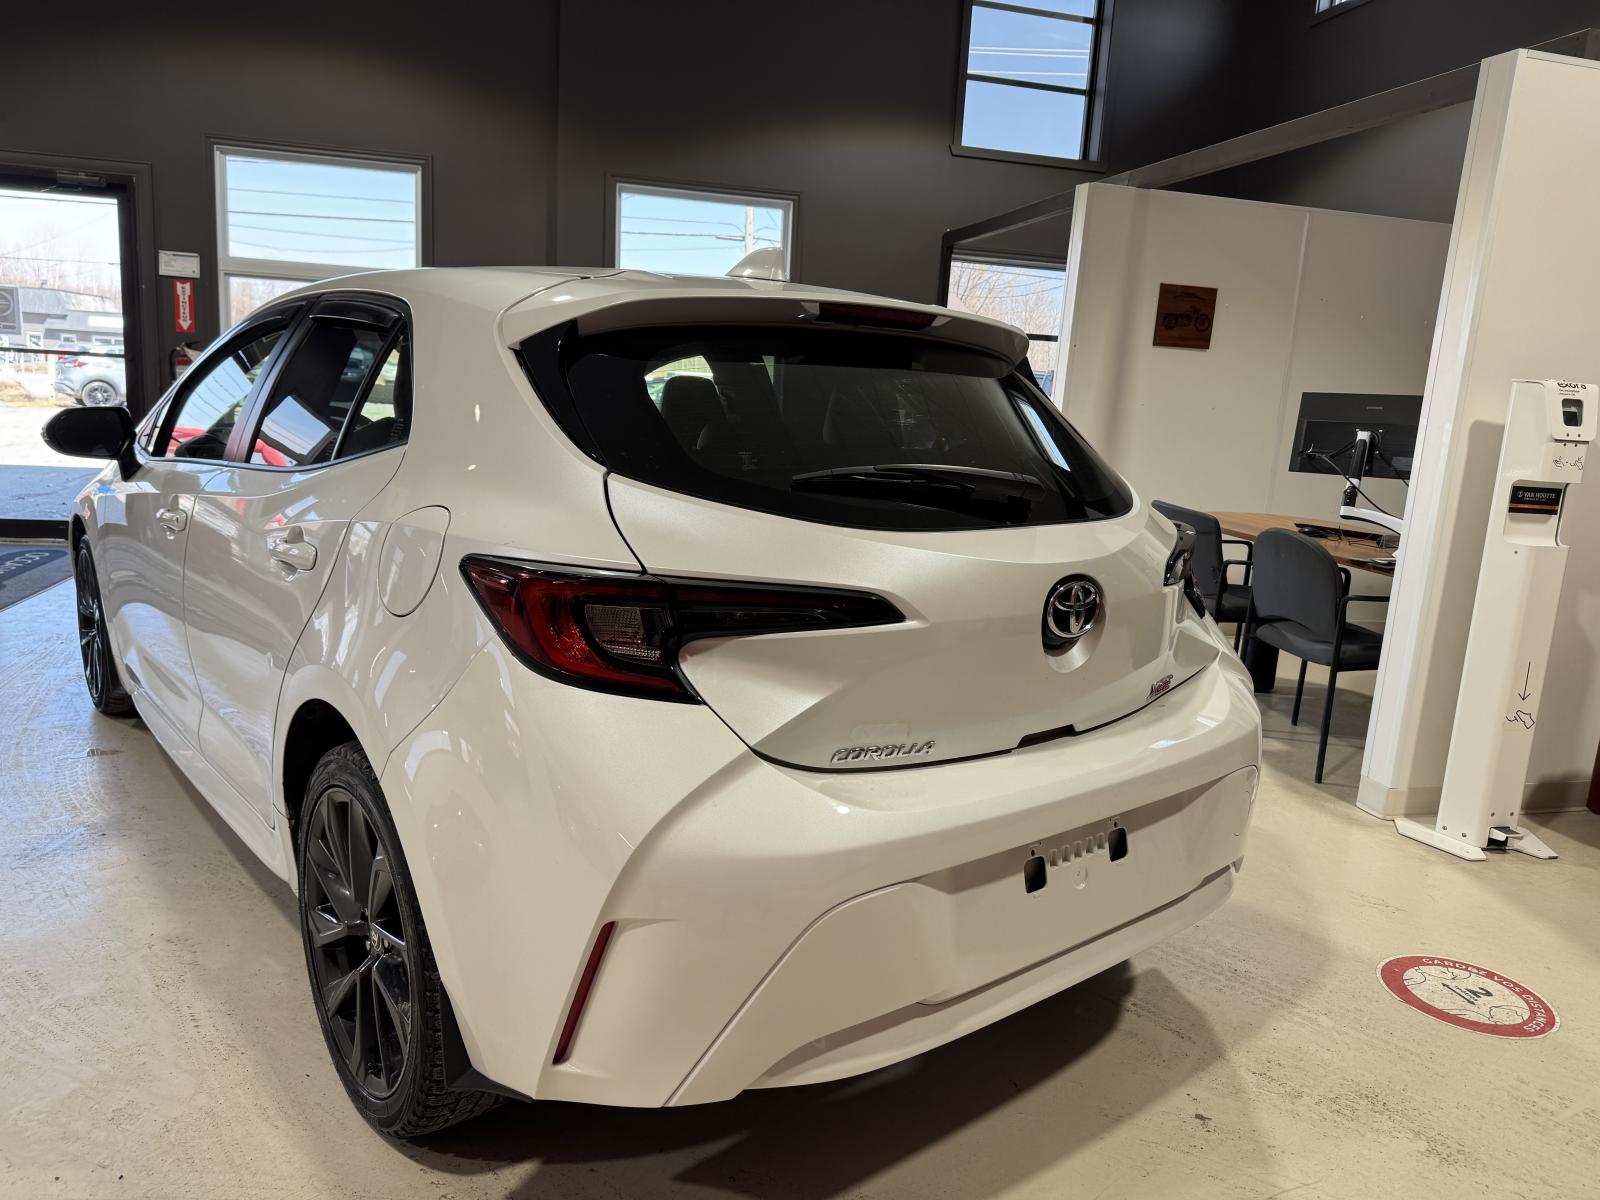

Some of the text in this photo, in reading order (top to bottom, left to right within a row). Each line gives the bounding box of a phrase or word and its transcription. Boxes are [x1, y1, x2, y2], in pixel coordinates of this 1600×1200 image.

[829, 740, 936, 764] COROLLA
[1421, 958, 1547, 1032] GARDEZ VOS DISTANCES
[1465, 986, 1493, 998] 2
